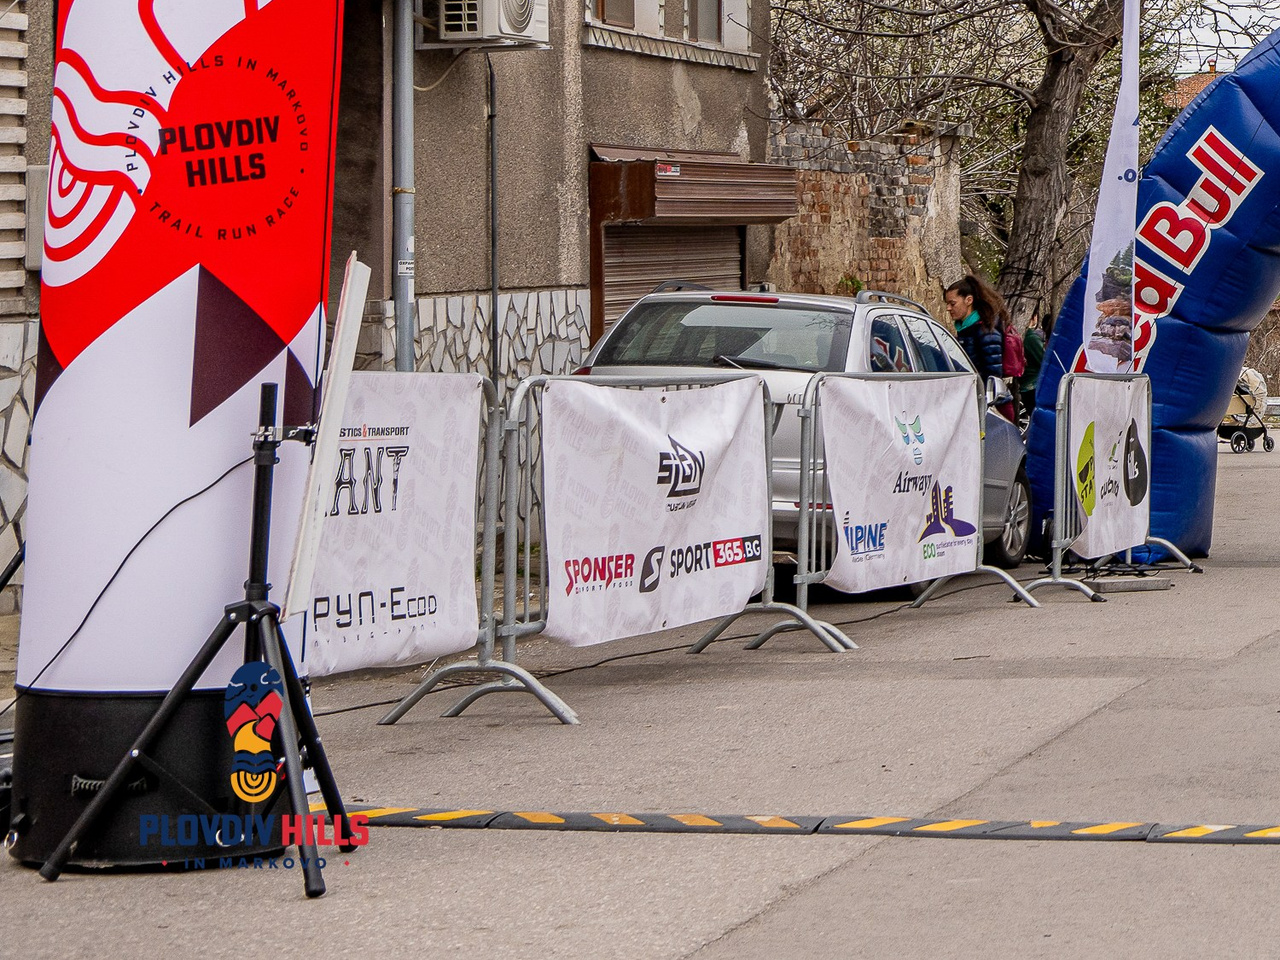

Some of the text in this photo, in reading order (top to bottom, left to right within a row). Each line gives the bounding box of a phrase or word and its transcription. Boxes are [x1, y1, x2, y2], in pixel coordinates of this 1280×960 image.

[125, 55, 309, 172] PLOVDIV HILLS IN MARKOVO
[158, 115, 280, 156] PLOVDIV
[185, 152, 267, 188] HILLS
[150, 186, 300, 240] TRAIL RUN RACE
[1136, 126, 1262, 273] Bull
[324, 446, 409, 518] ANT
[564, 553, 635, 596] SPONSER
[923, 542, 937, 560] ECO
